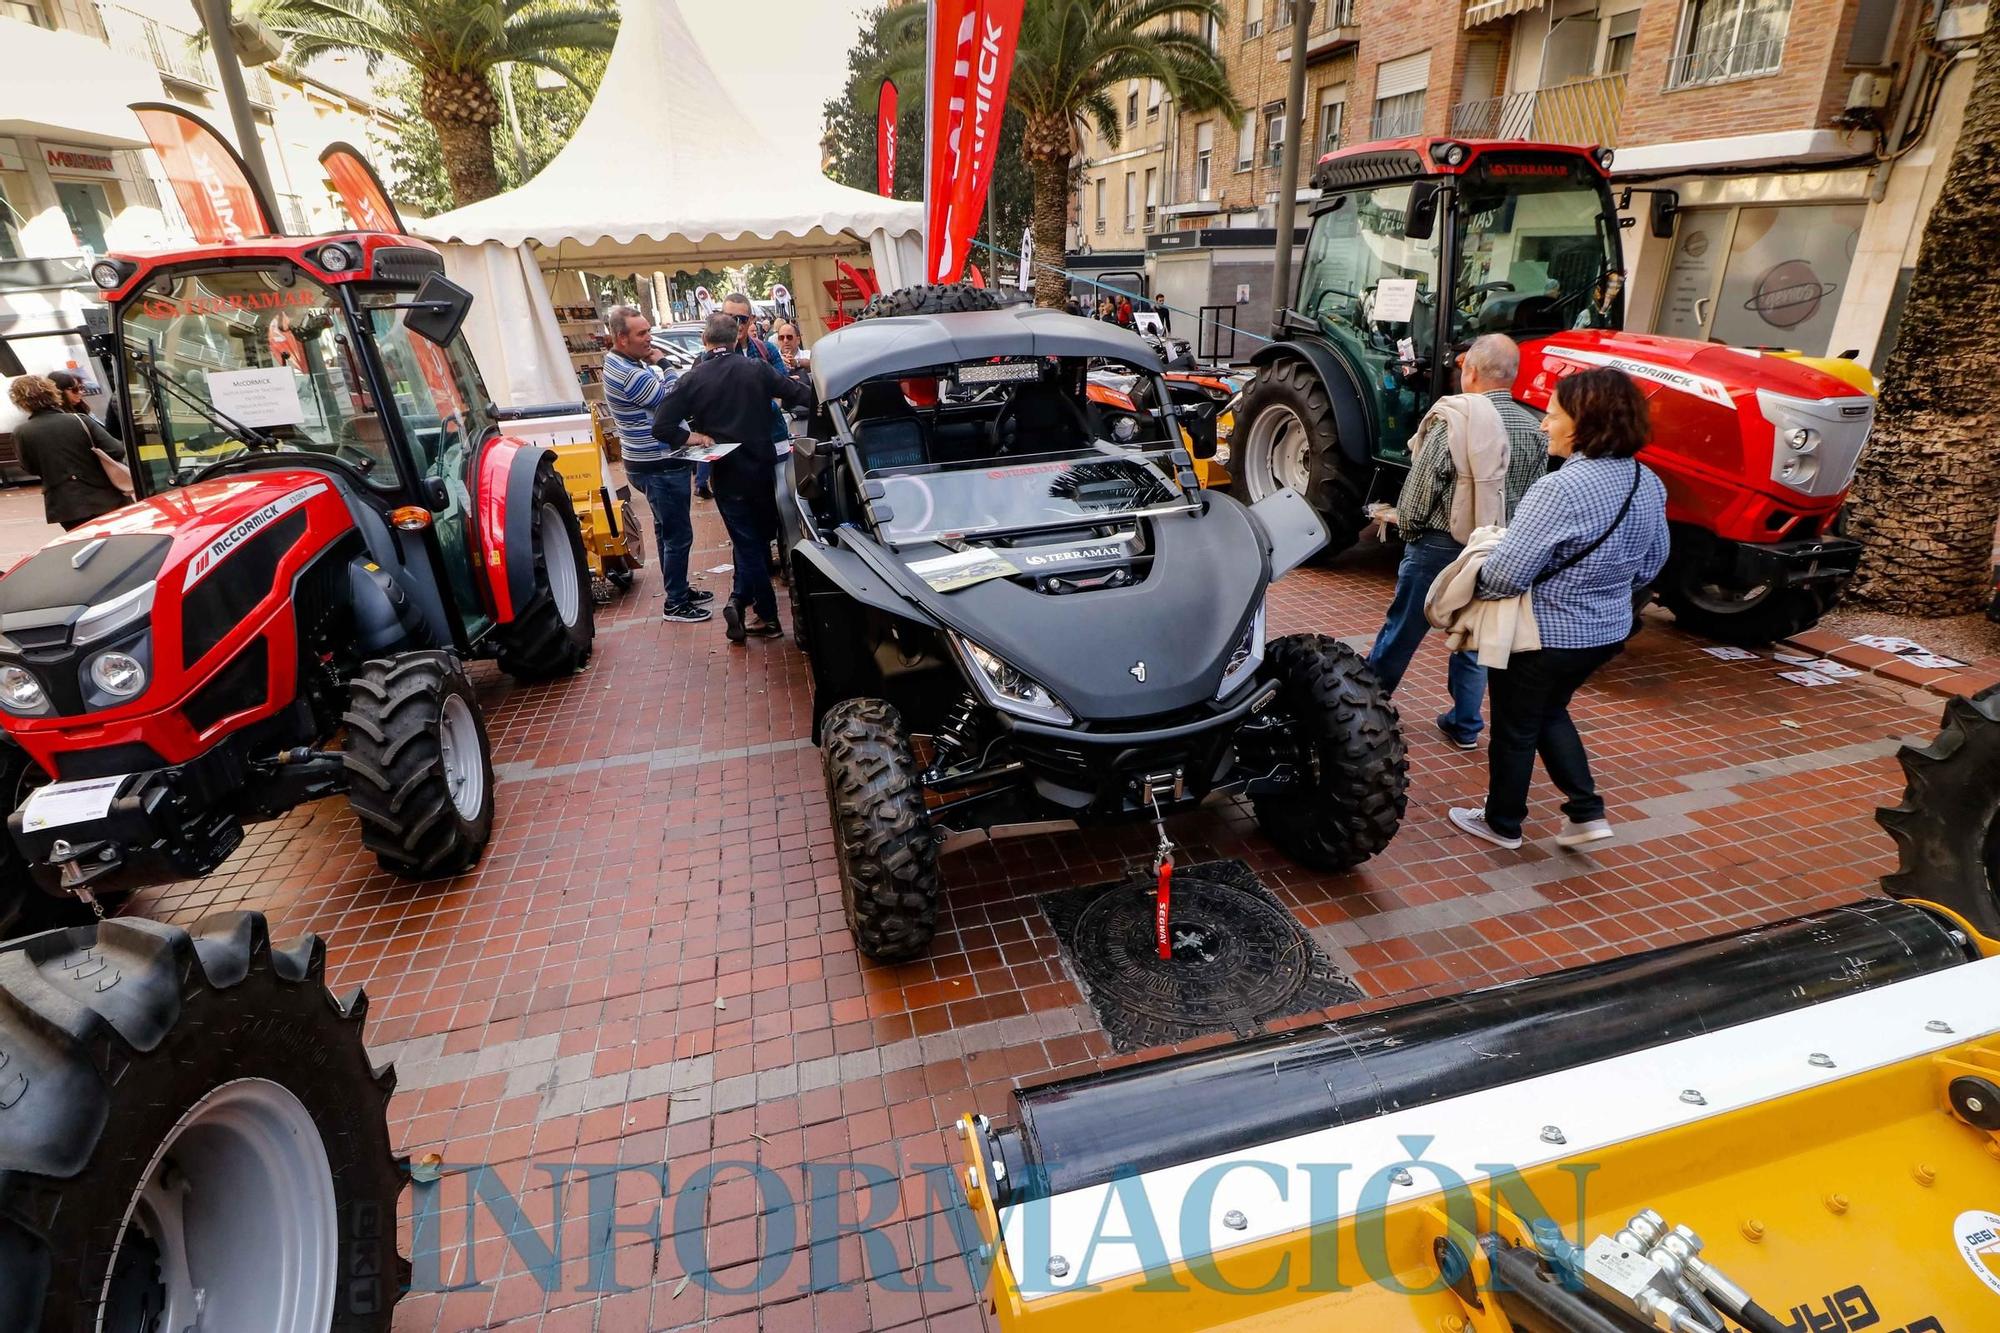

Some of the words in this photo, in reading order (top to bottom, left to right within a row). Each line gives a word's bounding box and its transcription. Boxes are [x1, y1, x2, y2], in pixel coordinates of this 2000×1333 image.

[1507, 164, 1568, 176] TERRAMAR
[183, 287, 315, 315] TERRAMAR
[1007, 463, 1072, 477] TERRAMAR
[1045, 547, 1121, 562] TERRAMAR
[1158, 902, 1168, 945] SEGWAY
[1965, 1228, 1997, 1246] 1930
[354, 1204, 381, 1311] BKT
